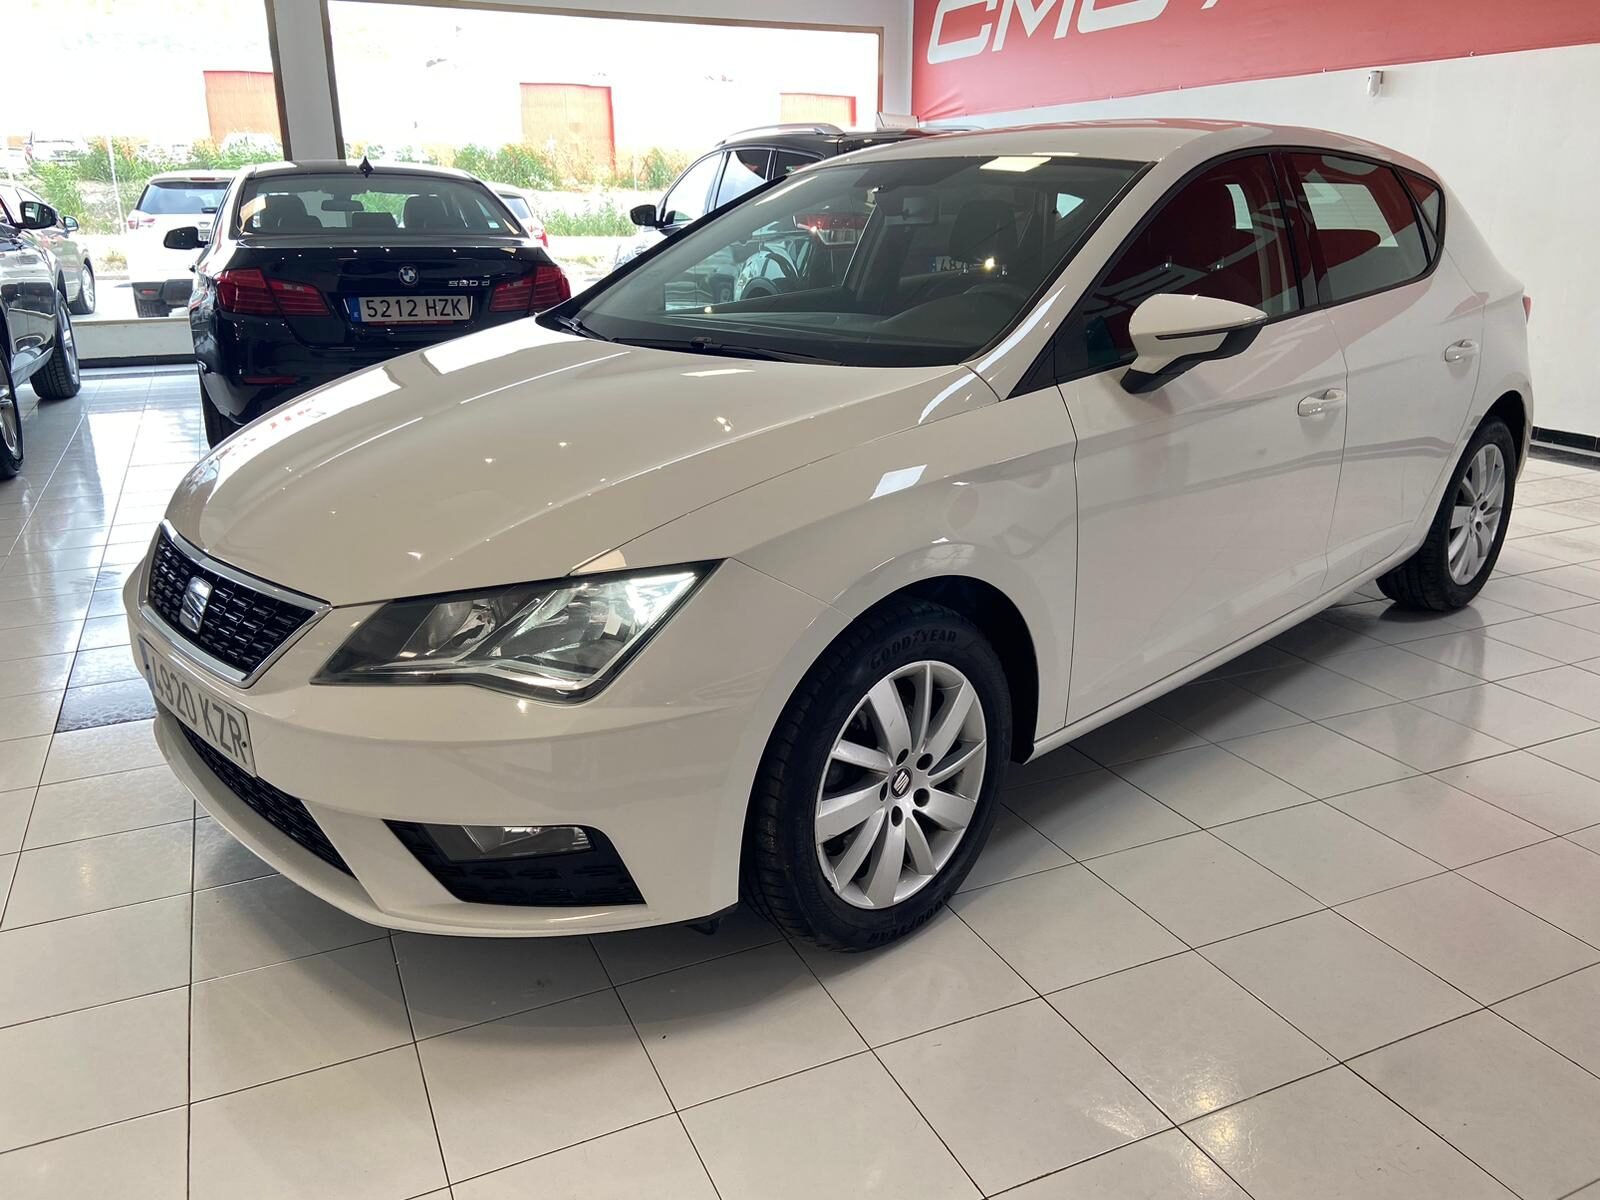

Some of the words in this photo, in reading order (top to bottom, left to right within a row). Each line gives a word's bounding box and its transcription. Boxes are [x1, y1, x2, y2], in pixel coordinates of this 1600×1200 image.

[366, 300, 418, 318] 5212
[425, 298, 463, 317] HZK
[870, 629, 958, 669] GOODYEAR
[152, 656, 198, 726] 4920
[198, 692, 248, 765] KZR
